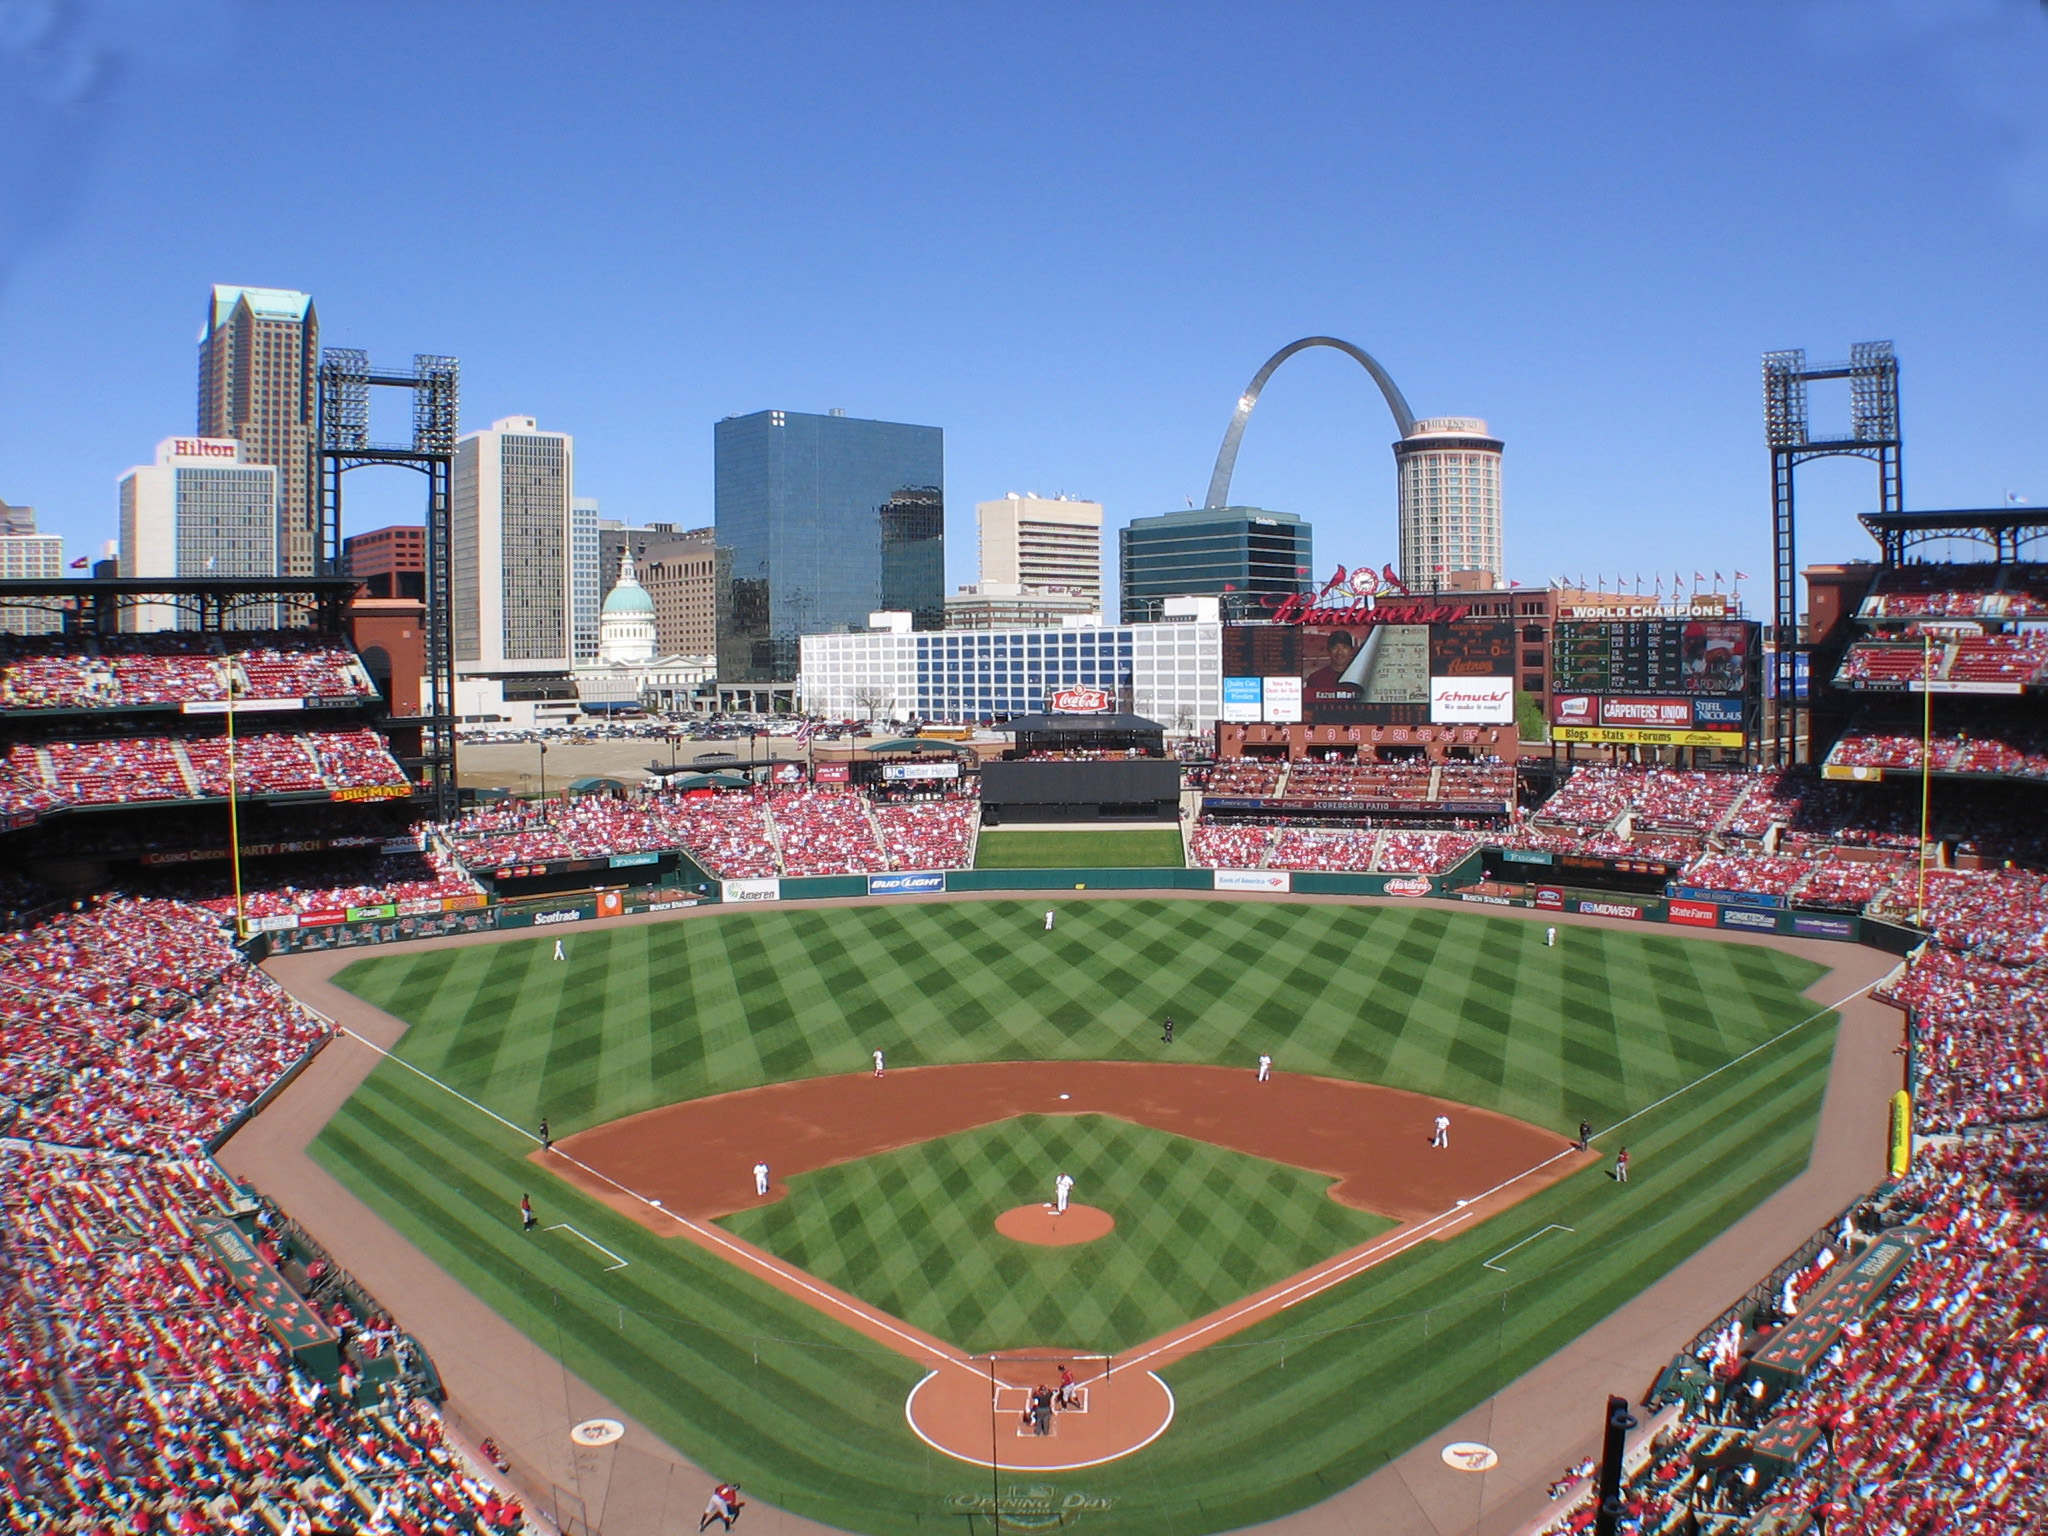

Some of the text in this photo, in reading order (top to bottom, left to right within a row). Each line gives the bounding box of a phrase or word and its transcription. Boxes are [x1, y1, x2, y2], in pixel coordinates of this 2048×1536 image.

[175, 438, 235, 458] Hilton
[1260, 592, 1471, 625] Budweiser
[1572, 604, 1724, 618] WORLD CHAMPIONS
[1435, 691, 1510, 702] Schnucks
[1695, 701, 1721, 711] STIFEL
[1660, 705, 1688, 720] UNION
[1698, 711, 1742, 721] NICOLAUS
[1565, 728, 1671, 742] Blogs Stats Forums
[885, 766, 957, 778] BJC Better Health
[342, 785, 404, 800] BIG MAC
[1313, 801, 1389, 810] SCOREBOARD PATIO
[150, 852, 188, 864] CASINO
[190, 849, 226, 860] QUEEN
[280, 840, 321, 853] PORCH
[871, 877, 942, 889] BUD LIGHT
[1218, 876, 1265, 885] Bank of America
[738, 890, 775, 900] Ameren
[1483, 895, 1510, 905] STADIUM
[671, 899, 698, 909] STADIUM
[1593, 902, 1637, 917] MIDWEST
[534, 909, 580, 925] Scottrade
[1691, 907, 1713, 919] Farm
